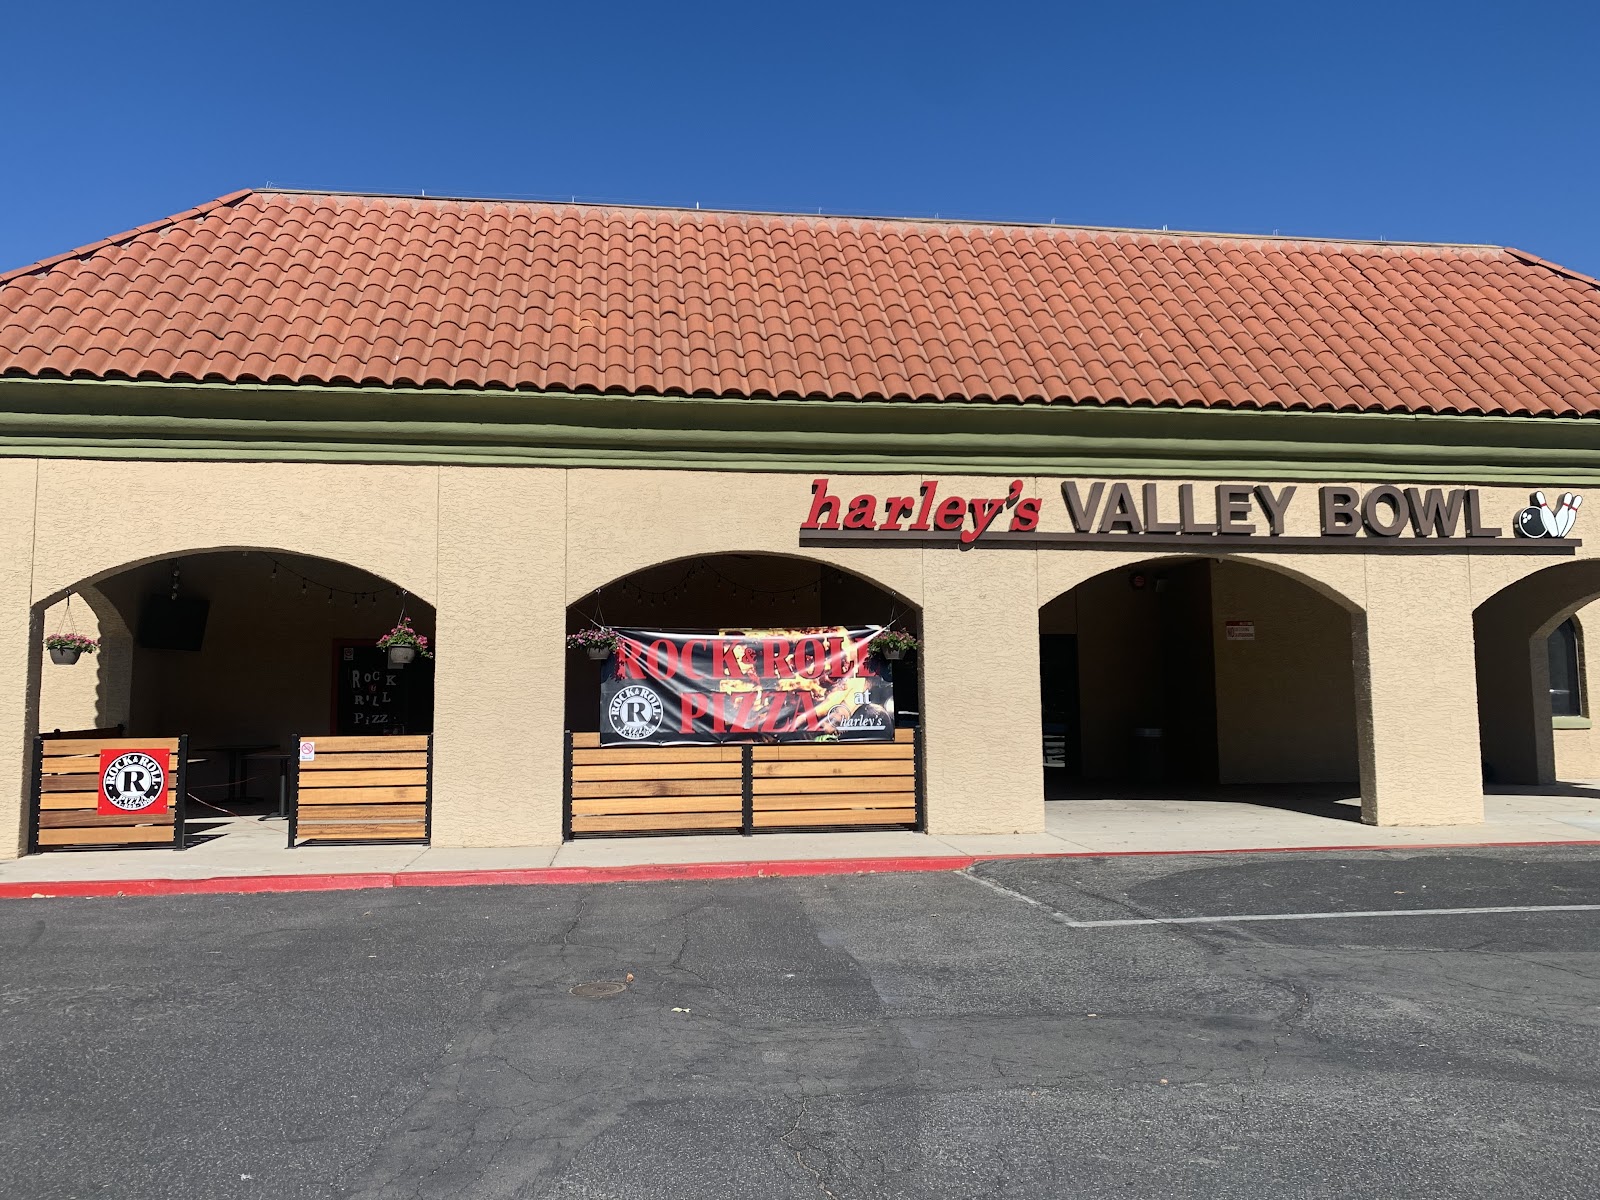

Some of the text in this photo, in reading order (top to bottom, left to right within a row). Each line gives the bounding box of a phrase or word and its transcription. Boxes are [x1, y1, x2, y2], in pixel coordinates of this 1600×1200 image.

[800, 479, 1502, 543] harley's VALLEY BOWL
[616, 638, 744, 680] ROCK
[626, 702, 647, 722] R
[679, 690, 825, 734] PIZZA
[854, 689, 872, 705] at
[121, 771, 145, 792] R
